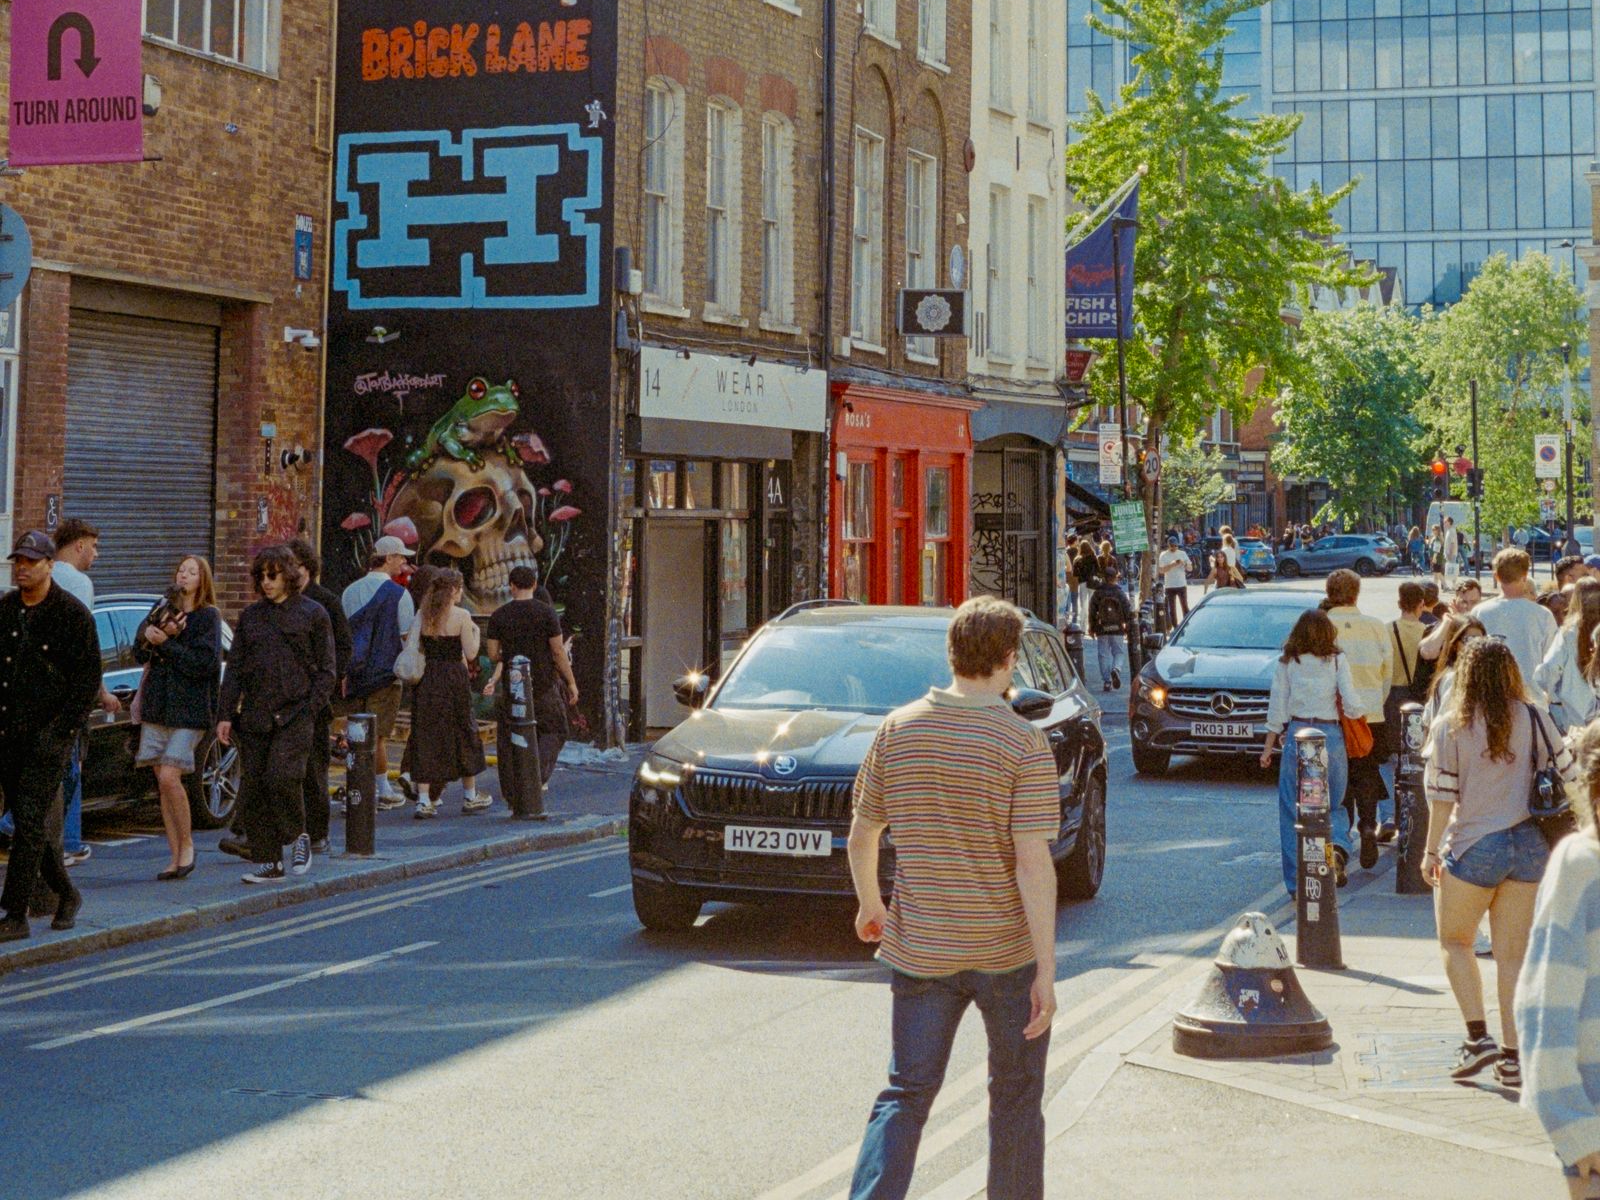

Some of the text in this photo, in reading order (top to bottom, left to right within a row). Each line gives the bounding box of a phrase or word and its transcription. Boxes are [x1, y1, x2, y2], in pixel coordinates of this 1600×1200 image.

[485, 19, 592, 73] LANE
[14, 96, 137, 126] TURN AROUND
[1066, 297, 1105, 310] FISH
[645, 367, 661, 397] 14
[716, 369, 765, 397] WEAR
[722, 400, 758, 413] LONDON
[845, 412, 870, 428] ROSA'S
[1145, 456, 1158, 473] 20
[1195, 723, 1249, 736] RK03 BJK
[732, 829, 823, 851] HY23 OVV
